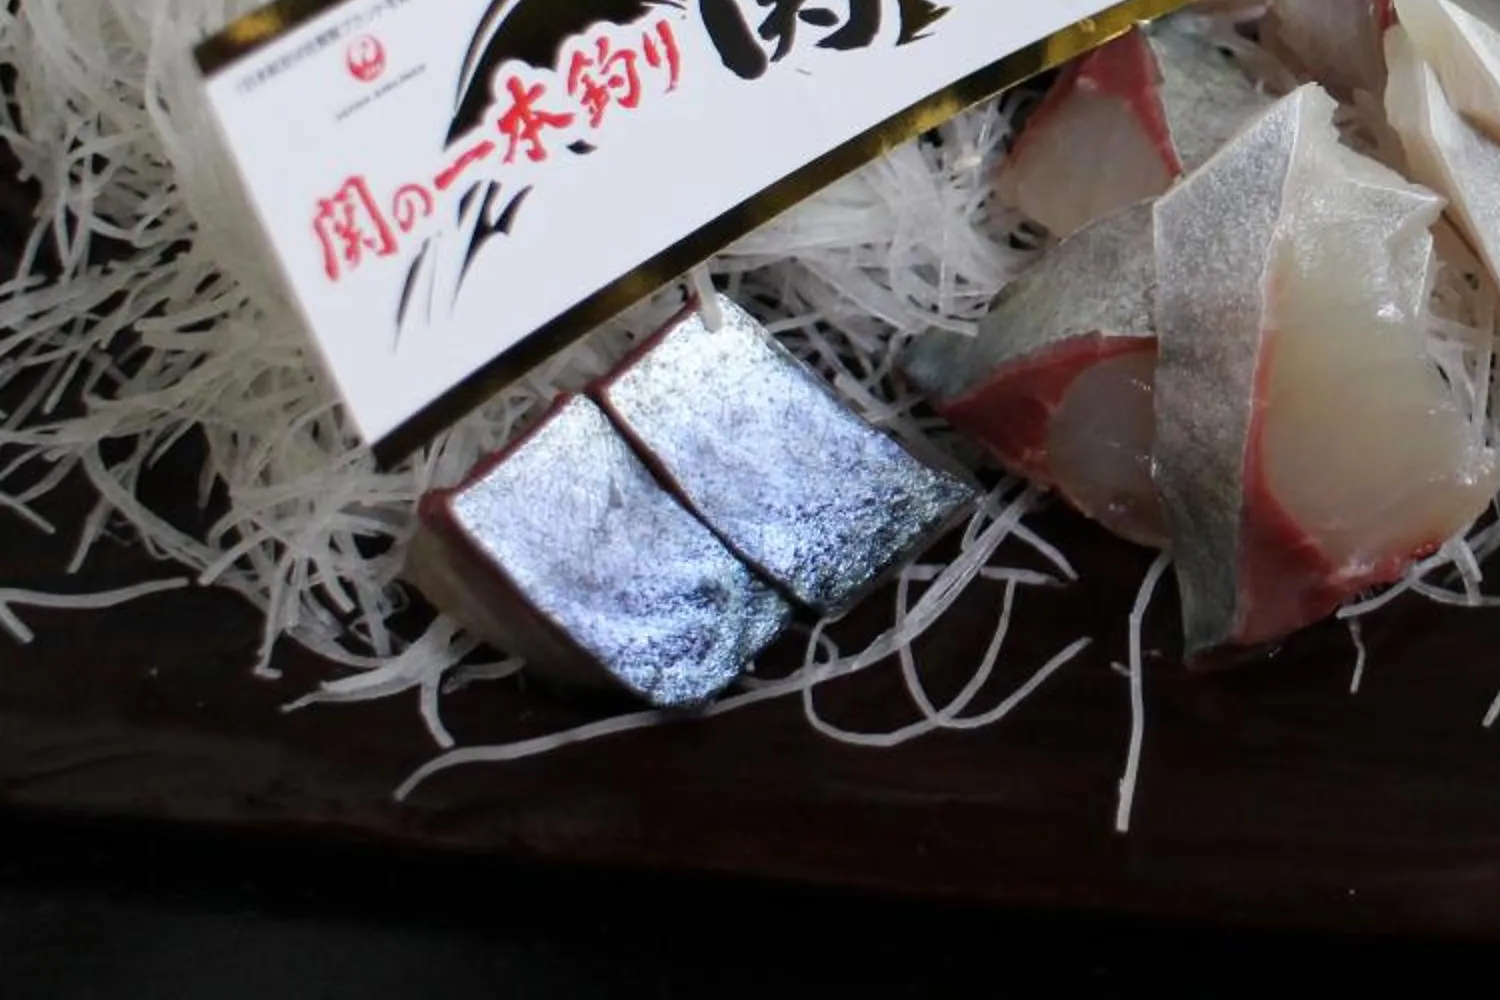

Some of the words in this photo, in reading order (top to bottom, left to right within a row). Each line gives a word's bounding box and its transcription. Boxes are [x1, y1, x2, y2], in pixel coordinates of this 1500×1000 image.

[313, 19, 681, 281] 関の一本釣り
